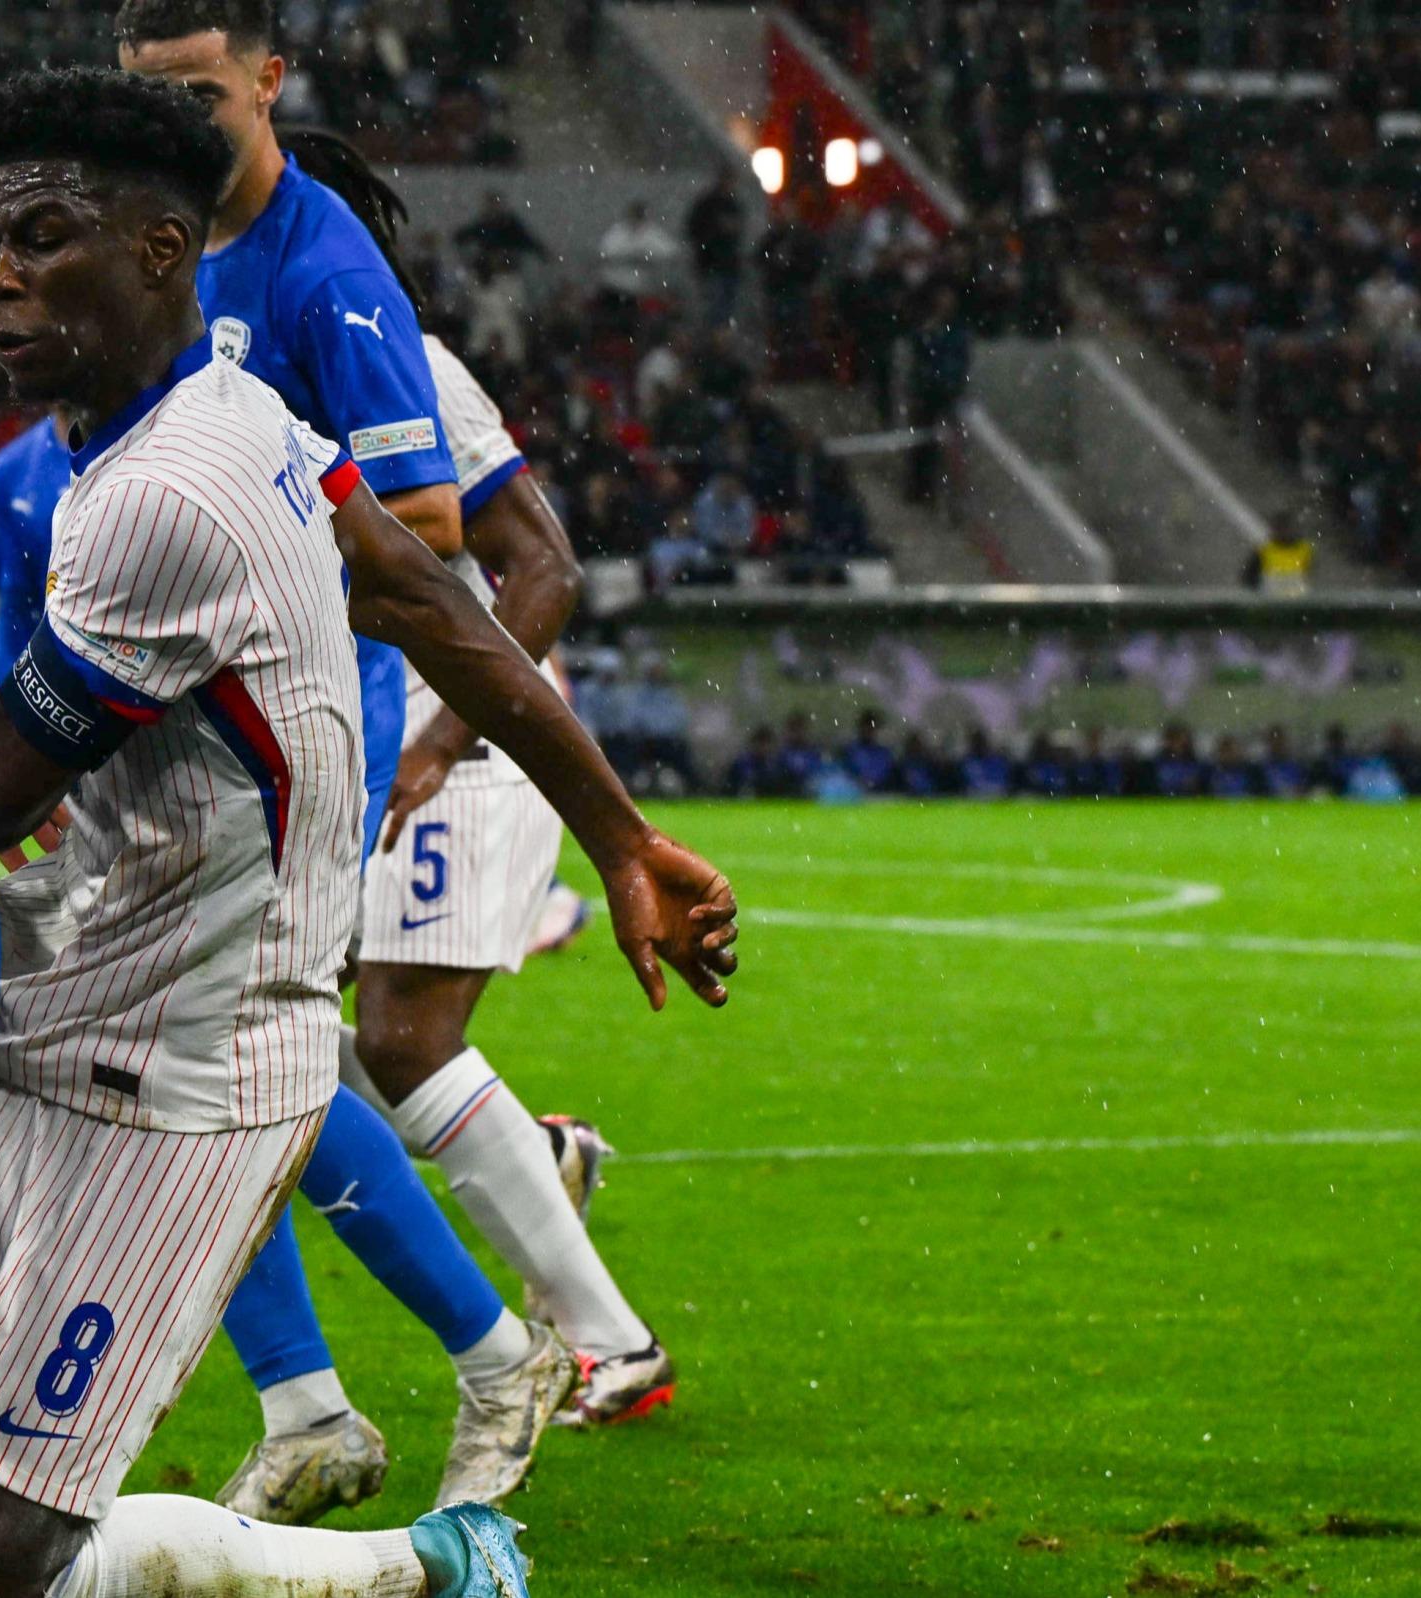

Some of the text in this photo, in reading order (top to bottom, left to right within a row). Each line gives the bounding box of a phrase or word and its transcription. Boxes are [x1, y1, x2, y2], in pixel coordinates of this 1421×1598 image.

[352, 428, 434, 451] FOUNDATION
[20, 667, 91, 739] RESPECT
[410, 821, 449, 904] 5
[35, 1301, 115, 1418] 8
